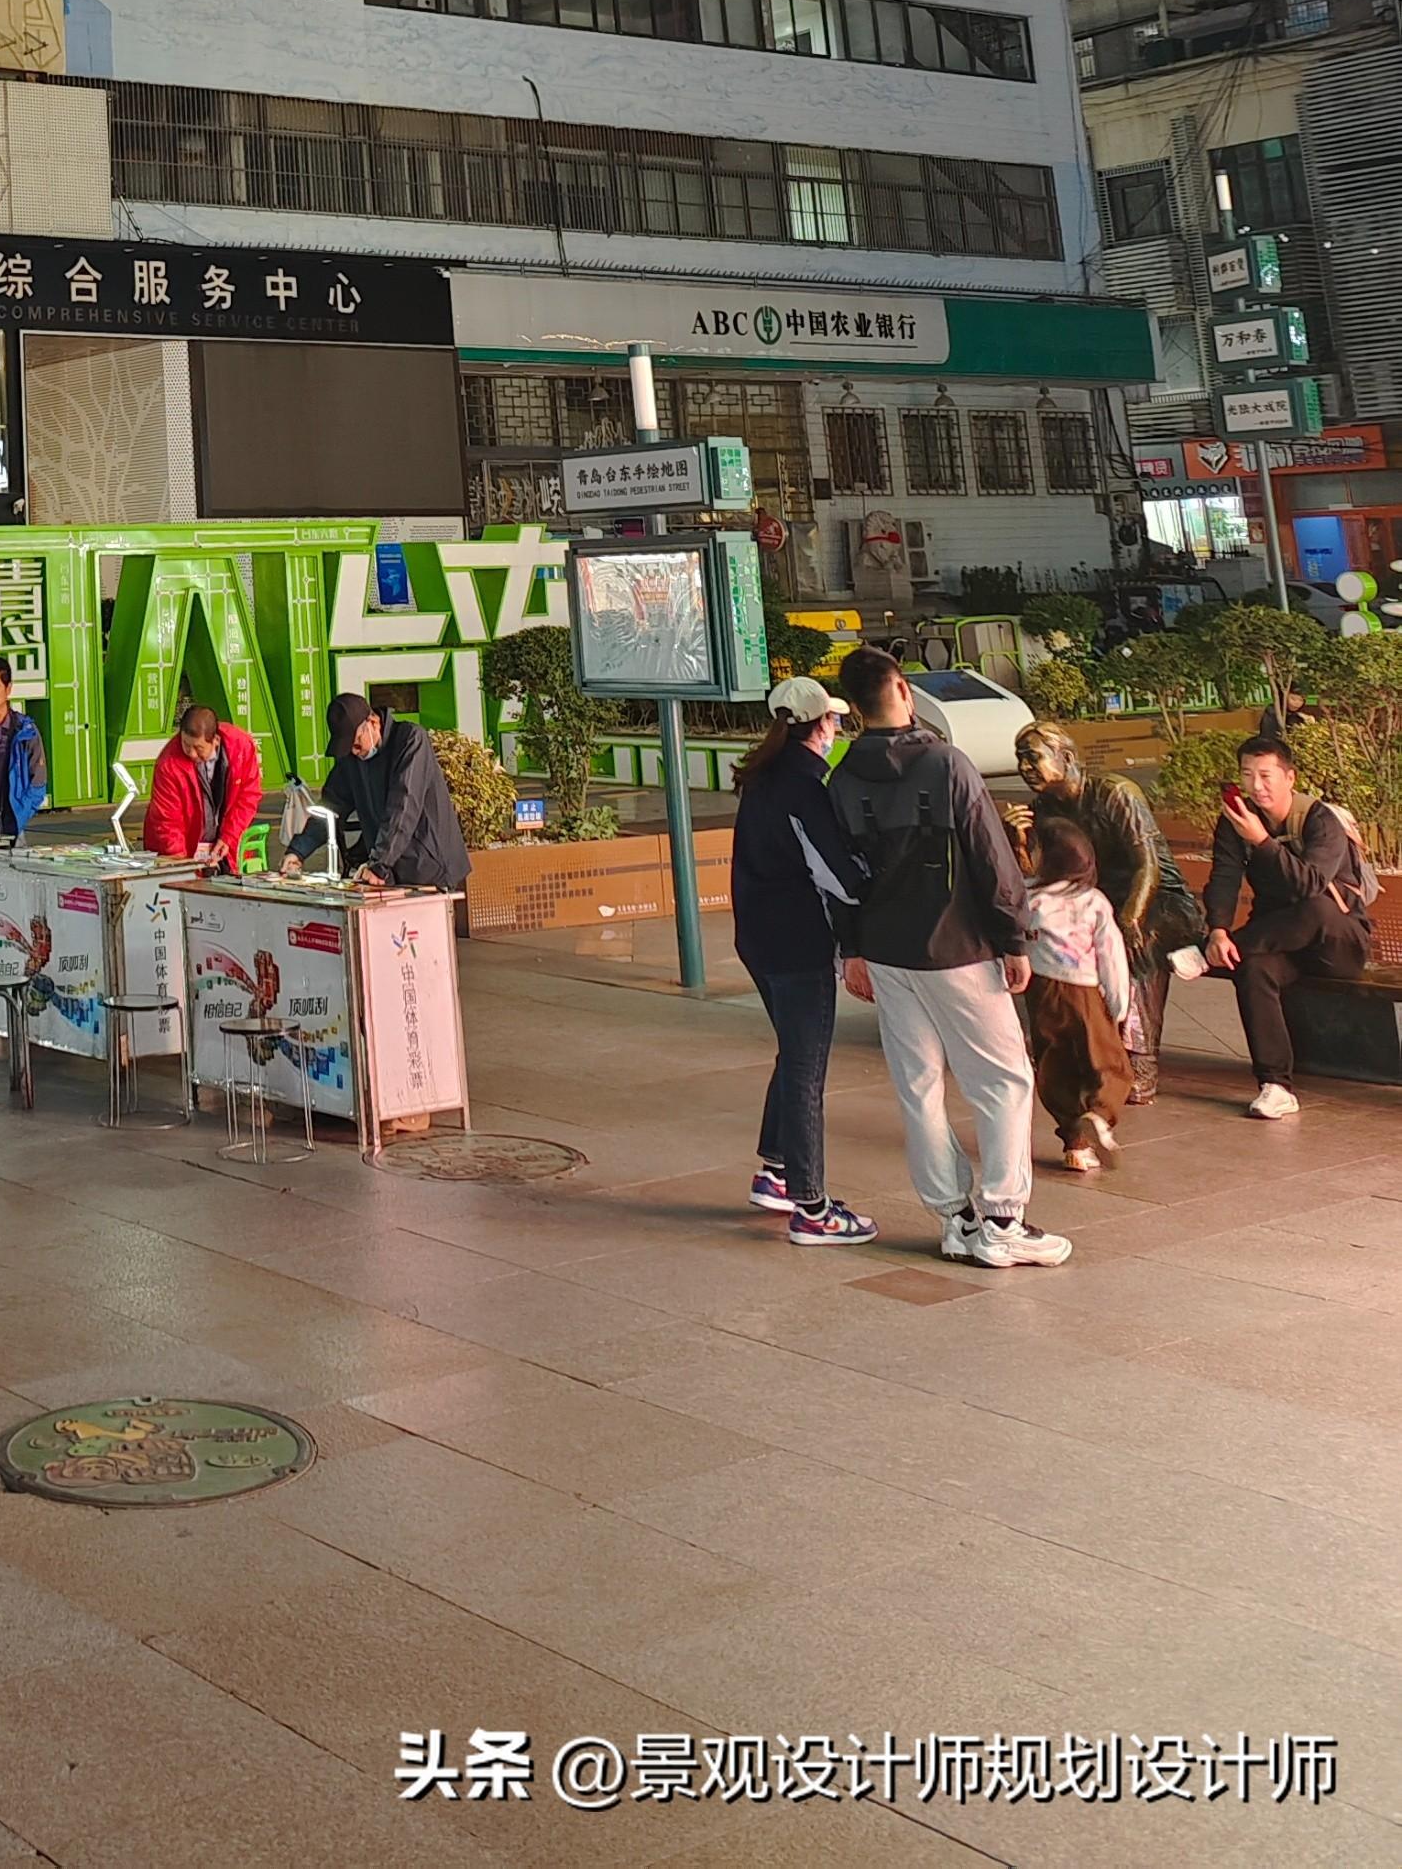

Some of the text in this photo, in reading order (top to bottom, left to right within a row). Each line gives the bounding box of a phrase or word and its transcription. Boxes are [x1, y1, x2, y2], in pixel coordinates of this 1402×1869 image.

[192, 313, 276, 331] SERVICE
[287, 317, 360, 333] CENTER
[692, 308, 917, 340] ABC 中国农业银行
[630, 484, 666, 495] PEDESTRIAN
[668, 482, 690, 492] STREET
[57, 953, 89, 973] 顶呱刮
[203, 998, 243, 1019] 相信自己
[288, 995, 329, 1017] 顶呱刮
[401, 961, 424, 1090] 中国体育彩票
